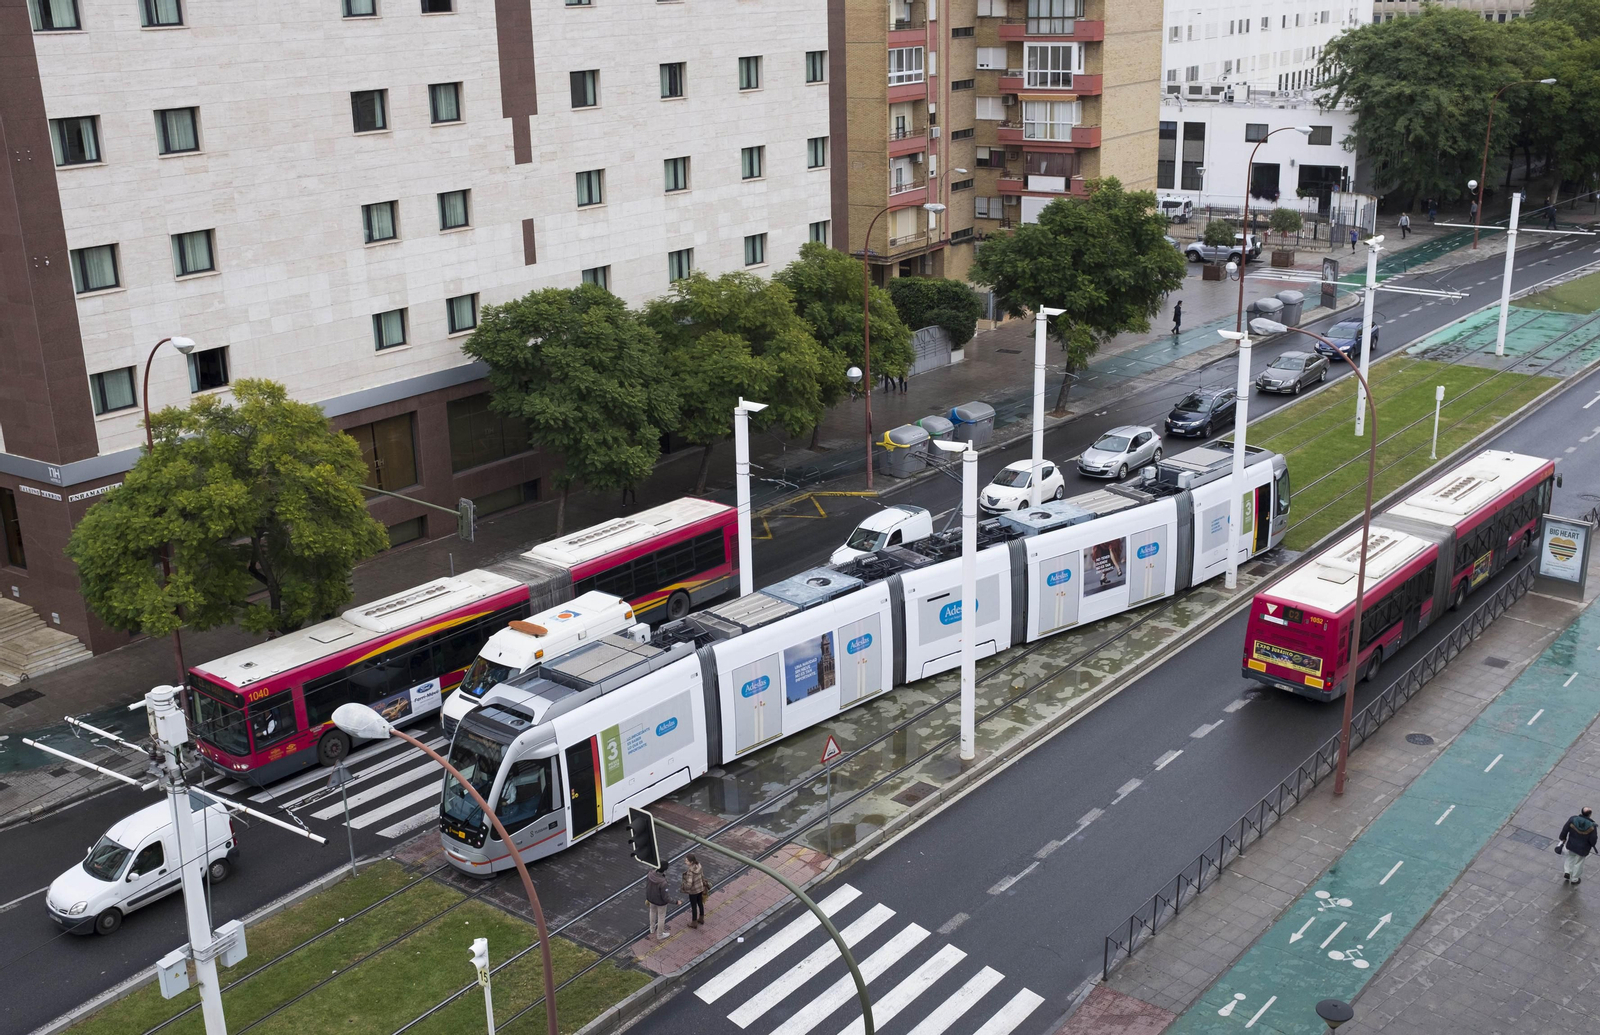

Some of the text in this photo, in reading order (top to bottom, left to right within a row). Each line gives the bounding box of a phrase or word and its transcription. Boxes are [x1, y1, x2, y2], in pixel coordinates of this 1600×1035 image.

[1549, 528, 1559, 536] BIG
[1560, 530, 1580, 540] HEART
[1050, 571, 1068, 582] Adeslas
[944, 604, 962, 618] Ades
[1288, 610, 1299, 620] C2
[1310, 616, 1323, 624] 1052
[850, 637, 870, 649] Adeslas
[1256, 642, 1271, 651] EXPO
[745, 679, 767, 692] Adeslas
[248, 687, 269, 702] 1040
[658, 721, 675, 733] Adeslas
[607, 741, 619, 761] 3
[480, 970, 488, 983] 15
